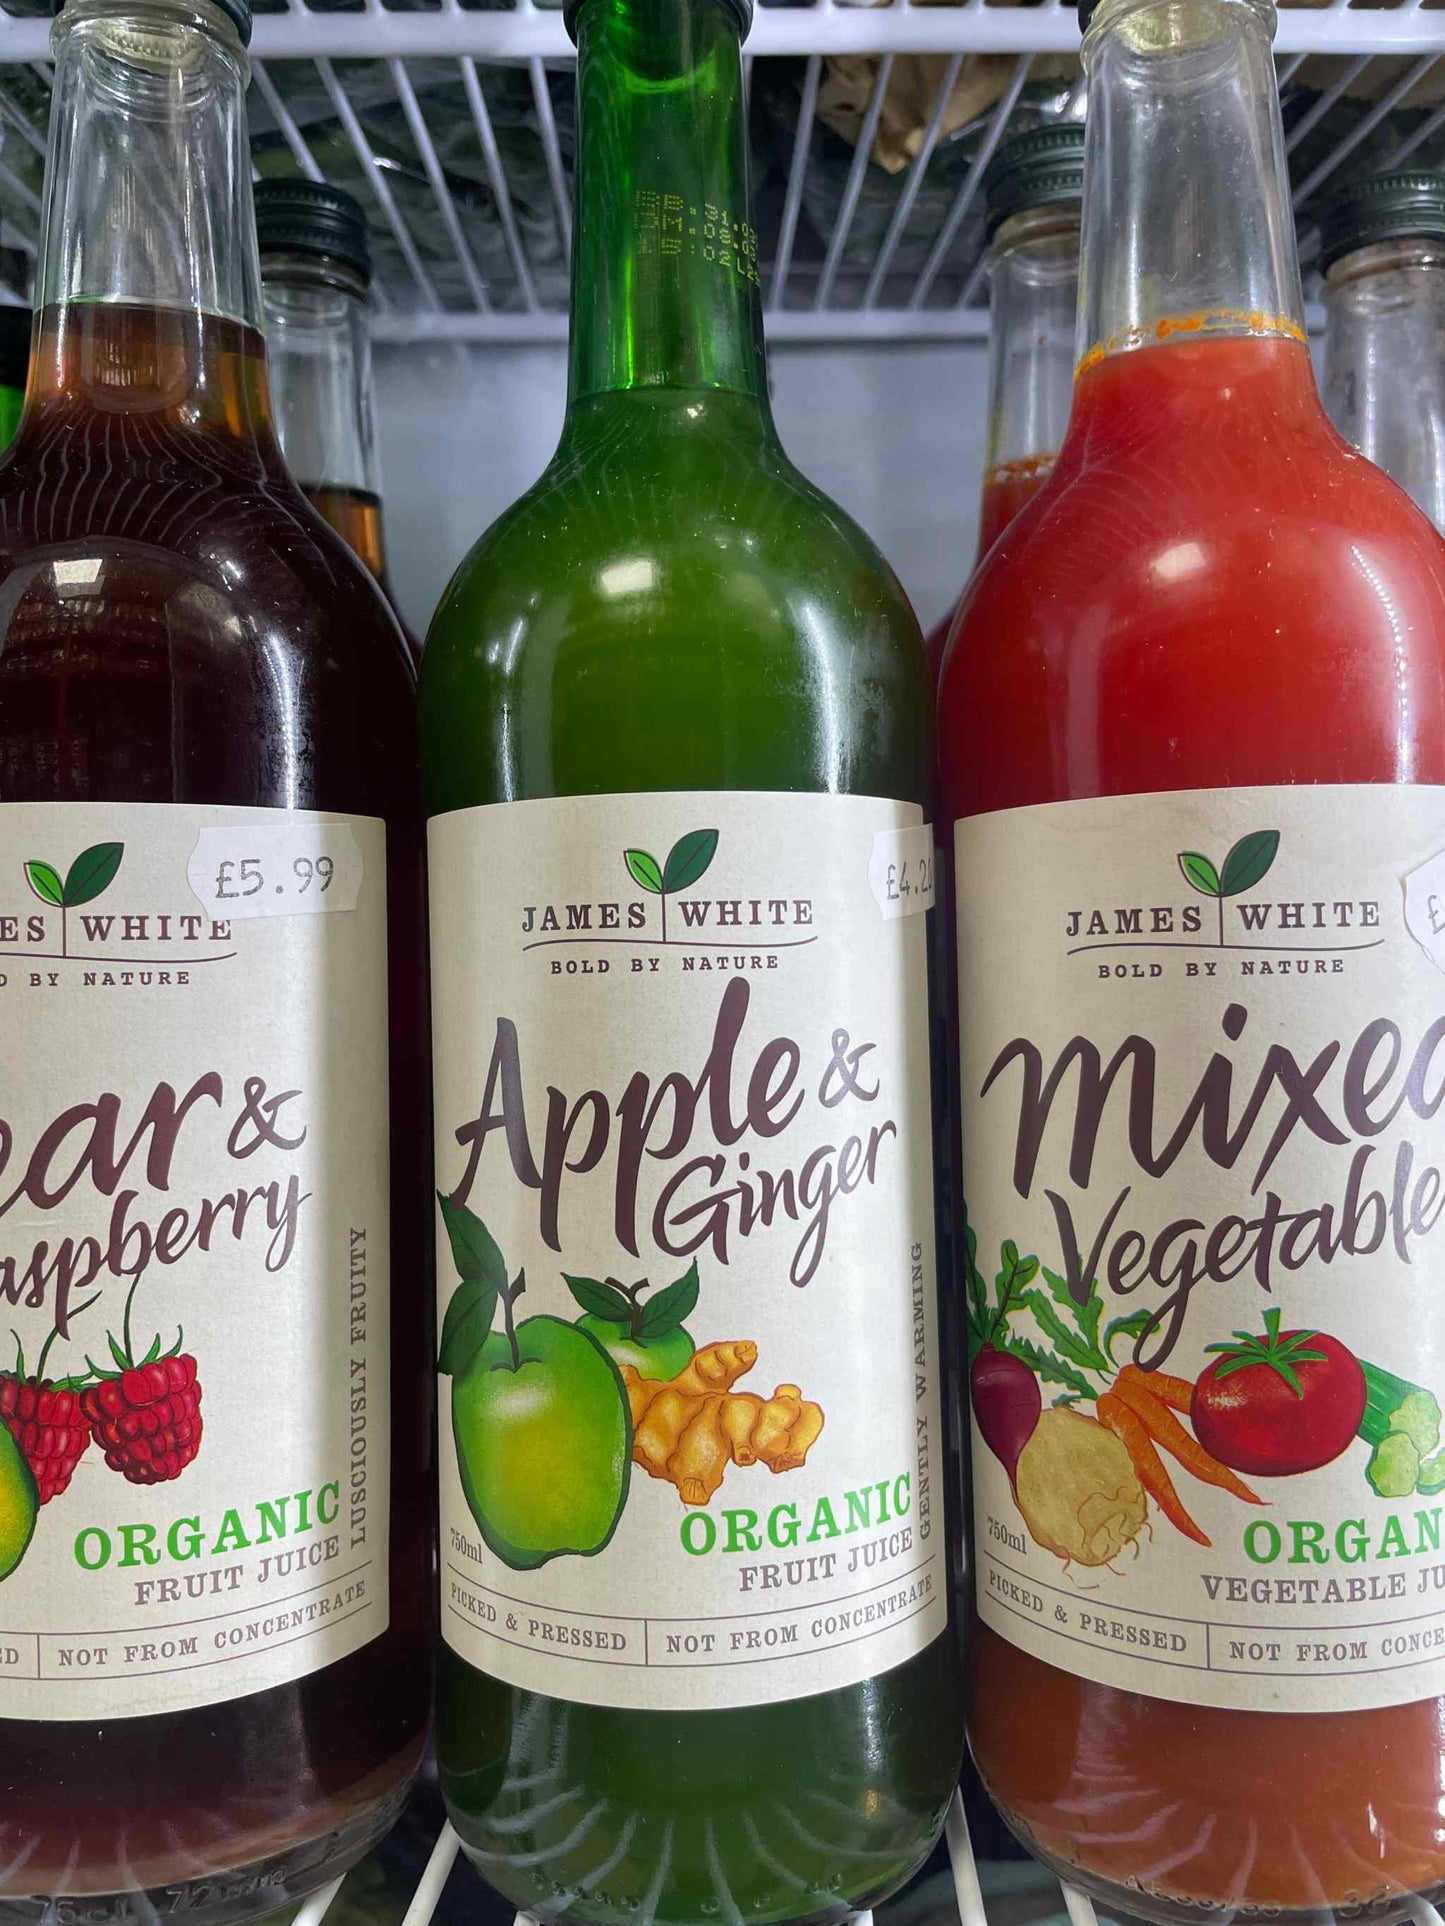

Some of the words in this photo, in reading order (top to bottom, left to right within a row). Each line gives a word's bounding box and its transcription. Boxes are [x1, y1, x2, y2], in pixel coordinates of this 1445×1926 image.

[214, 855, 334, 899] £5.99
[80, 914, 232, 942] WHITE
[522, 902, 647, 933] JAMES
[678, 900, 814, 928] WHITE
[1066, 905, 1203, 937] JAMES
[1236, 902, 1380, 930] WHITE
[29, 973, 60, 987] BY
[83, 971, 190, 987] NATURE
[551, 959, 611, 975] BOLD
[631, 957, 660, 973] BY
[682, 955, 779, 971] NATURE
[1098, 964, 1163, 980] BOLD
[1186, 962, 1217, 977] BY
[1241, 959, 1345, 975] NATURE
[227, 1076, 307, 1160] &
[454, 976, 805, 1258] Apple
[818, 1028, 880, 1108] &
[652, 1119, 897, 1287] Ginger
[350, 1227, 367, 1346] FRUITY
[911, 1241, 926, 1403] WARMING
[350, 1357, 367, 1550] LUSCIOUSLY
[916, 1415, 931, 1540] GENTLY
[74, 1480, 340, 1571] ORGANIC
[451, 1527, 483, 1564] 750ml
[679, 1472, 911, 1556] ORGANIC
[987, 1516, 1027, 1555] 750ml
[134, 1566, 244, 1606] FRUIT
[257, 1535, 340, 1583] JUICE
[738, 1554, 837, 1592] FRUIT
[848, 1526, 913, 1574] JUICE
[1200, 1572, 1407, 1604] VEGETABLE
[59, 1648, 108, 1666] NOT
[124, 1637, 198, 1662] FROM
[214, 1581, 366, 1649] CONCENTRATE
[451, 1582, 497, 1623] PICKED
[505, 1613, 519, 1632] &
[528, 1620, 627, 1652] PRESSED
[666, 1633, 716, 1653] NOT
[730, 1625, 798, 1651] FROM
[811, 1573, 933, 1638] CONCENTRATE
[988, 1569, 1044, 1614] PICKED
[1054, 1604, 1069, 1624] &
[1079, 1612, 1188, 1653] PRESSED
[1229, 1641, 1281, 1662] NOT
[1296, 1641, 1369, 1663] FROM
